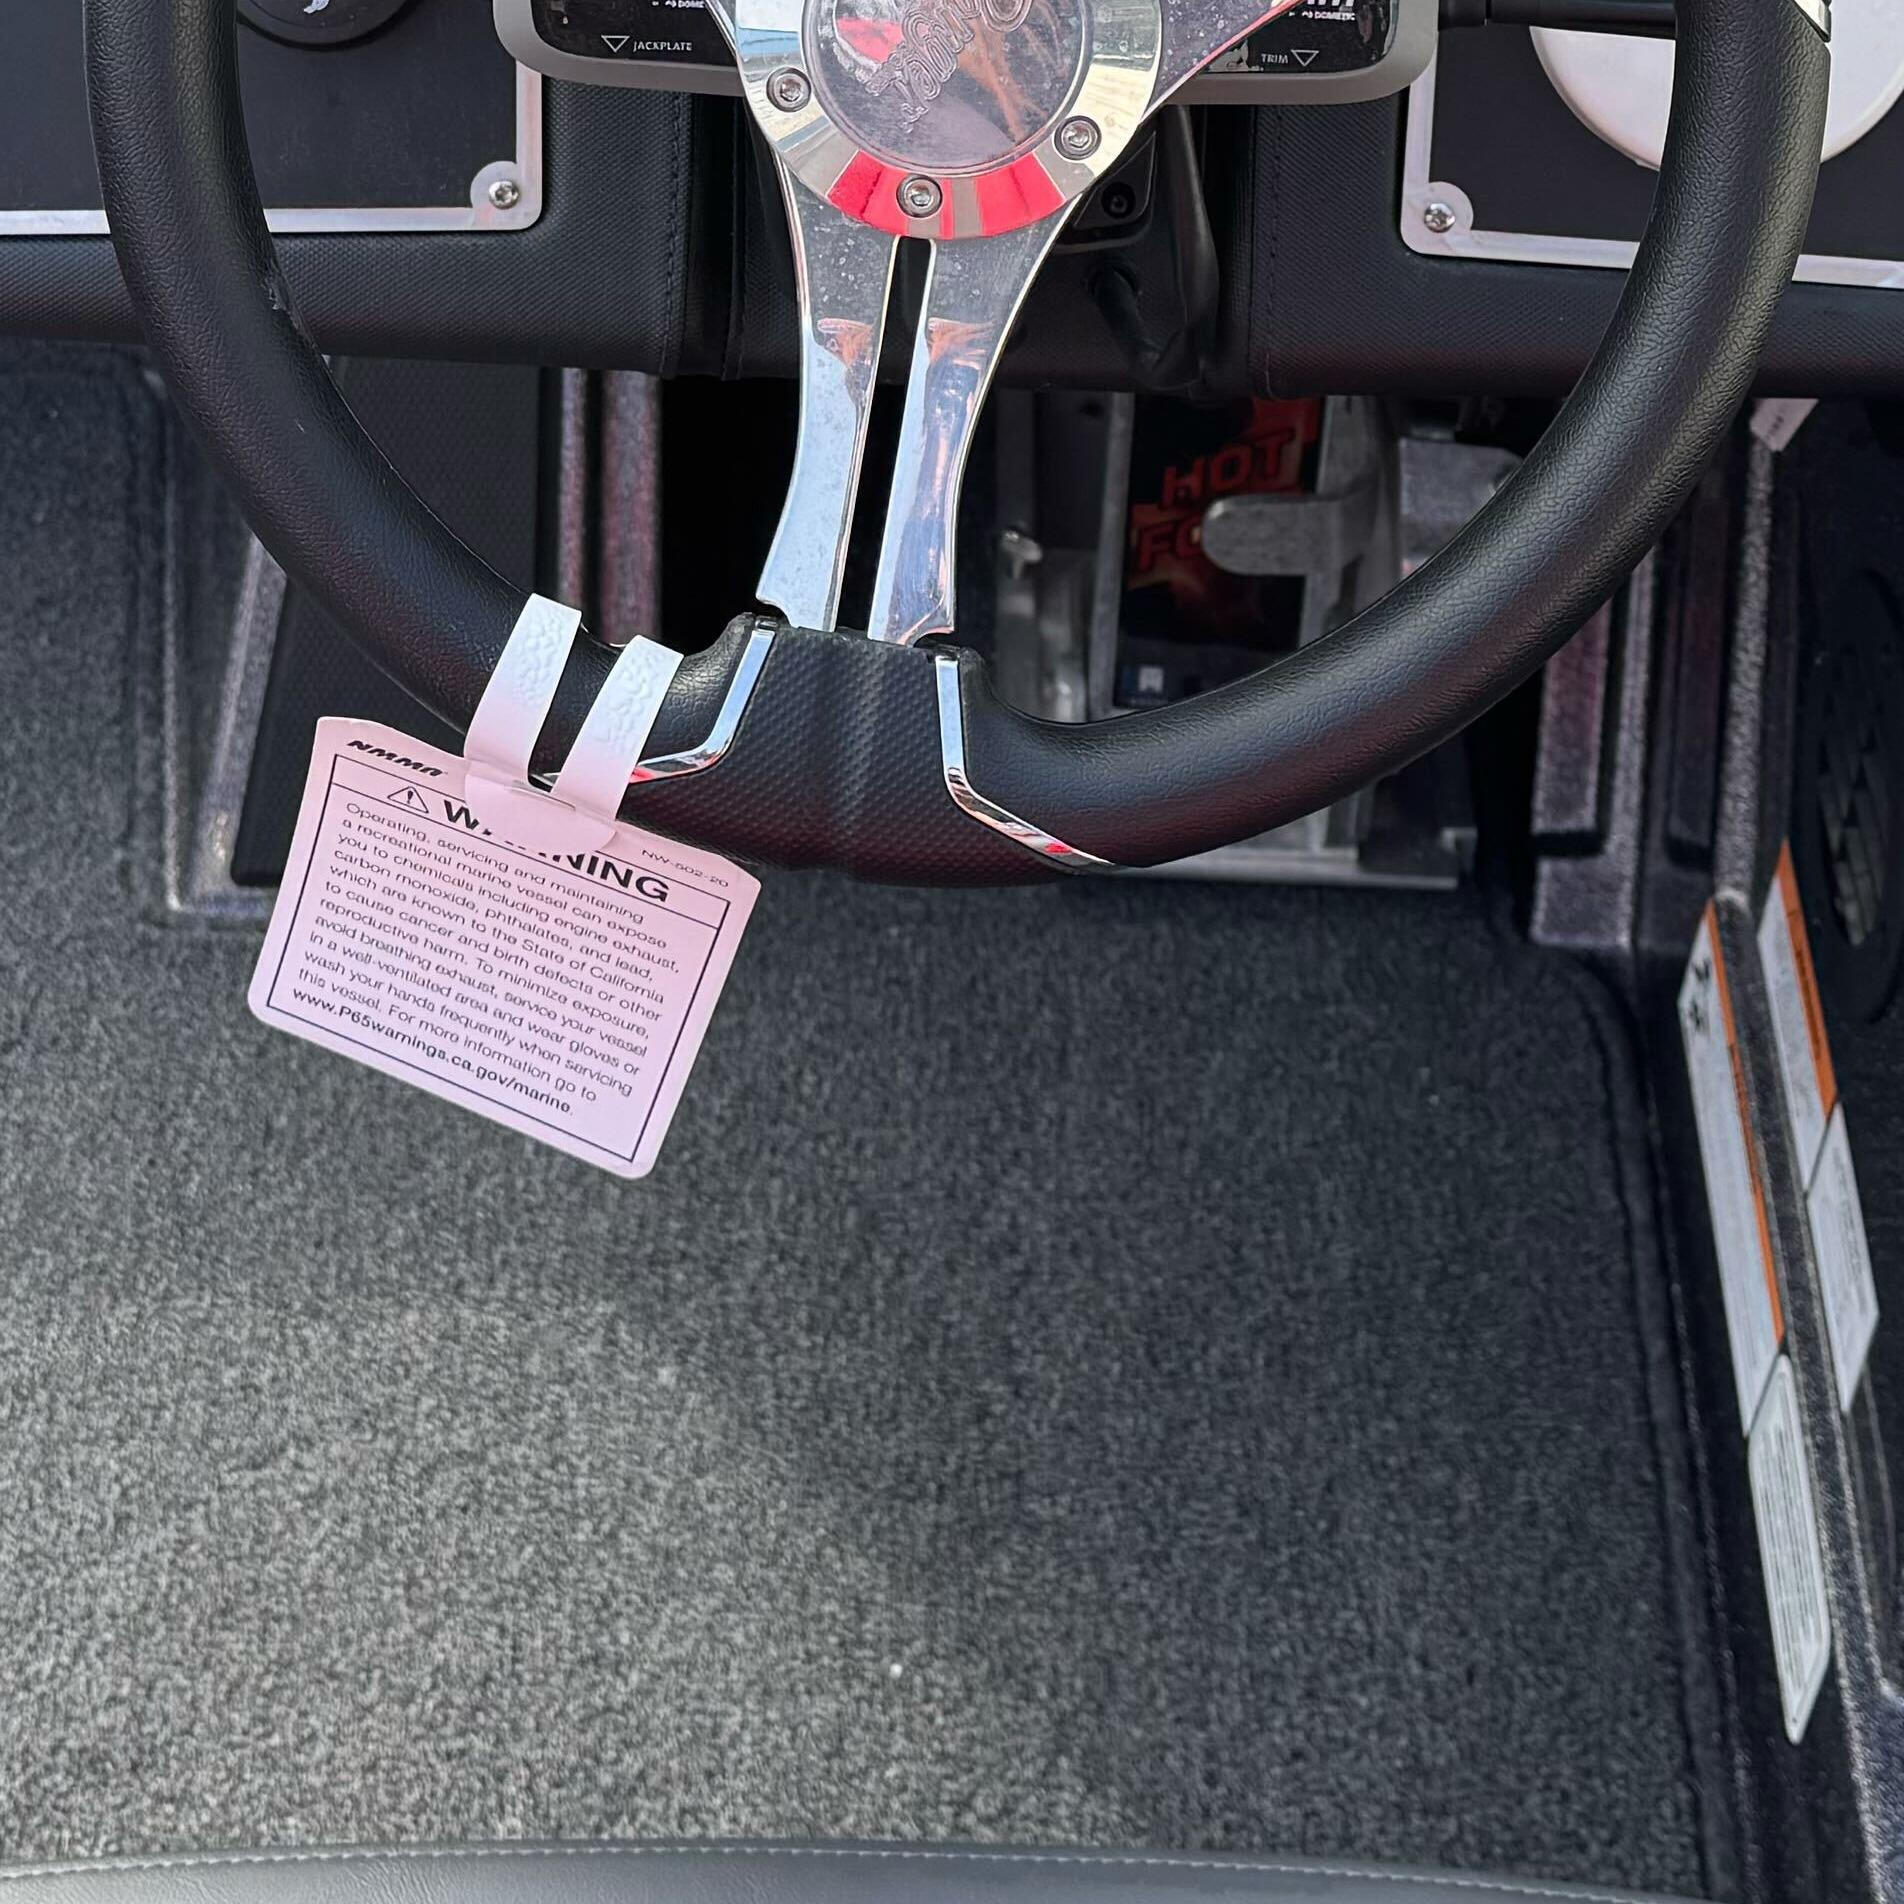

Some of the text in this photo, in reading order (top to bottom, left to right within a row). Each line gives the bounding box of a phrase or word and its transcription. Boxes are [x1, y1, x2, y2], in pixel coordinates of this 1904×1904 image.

[632, 41, 693, 53] JACKPLATE
[1260, 52, 1289, 65] TRIM
[1162, 427, 1296, 511] HOT
[332, 848, 394, 878] carbon
[577, 943, 613, 964] and
[336, 832, 368, 853] you
[372, 843, 391, 862] to
[392, 854, 474, 893] chemicals
[476, 883, 550, 924] including
[552, 916, 609, 945] engine
[340, 817, 667, 950] a recreational marine vessel can expose
[435, 837, 509, 874] servicing
[512, 866, 547, 887] and
[548, 880, 644, 926] maintaining
[641, 849, 729, 889] NW-502-20
[313, 914, 358, 940] avoid
[358, 929, 432, 972] breathing
[503, 990, 558, 1021] service
[559, 1012, 597, 1035] your
[598, 1028, 648, 1058] vessel
[318, 897, 420, 945] reproductive
[474, 955, 494, 975] To
[496, 967, 569, 1005] minimize
[324, 879, 663, 1022] to cause cancer and birth defects or other
[328, 863, 664, 1005] which are known to the State of California
[297, 966, 327, 989] this
[386, 1002, 417, 1025] For
[416, 1018, 460, 1044] more
[462, 1033, 552, 1083] information
[553, 1075, 577, 1093] go
[579, 1084, 597, 1102] to
[303, 949, 633, 1098] wash your hands frequently when servicing
[308, 929, 641, 1076] in a well-ventilated area and wear gloves or
